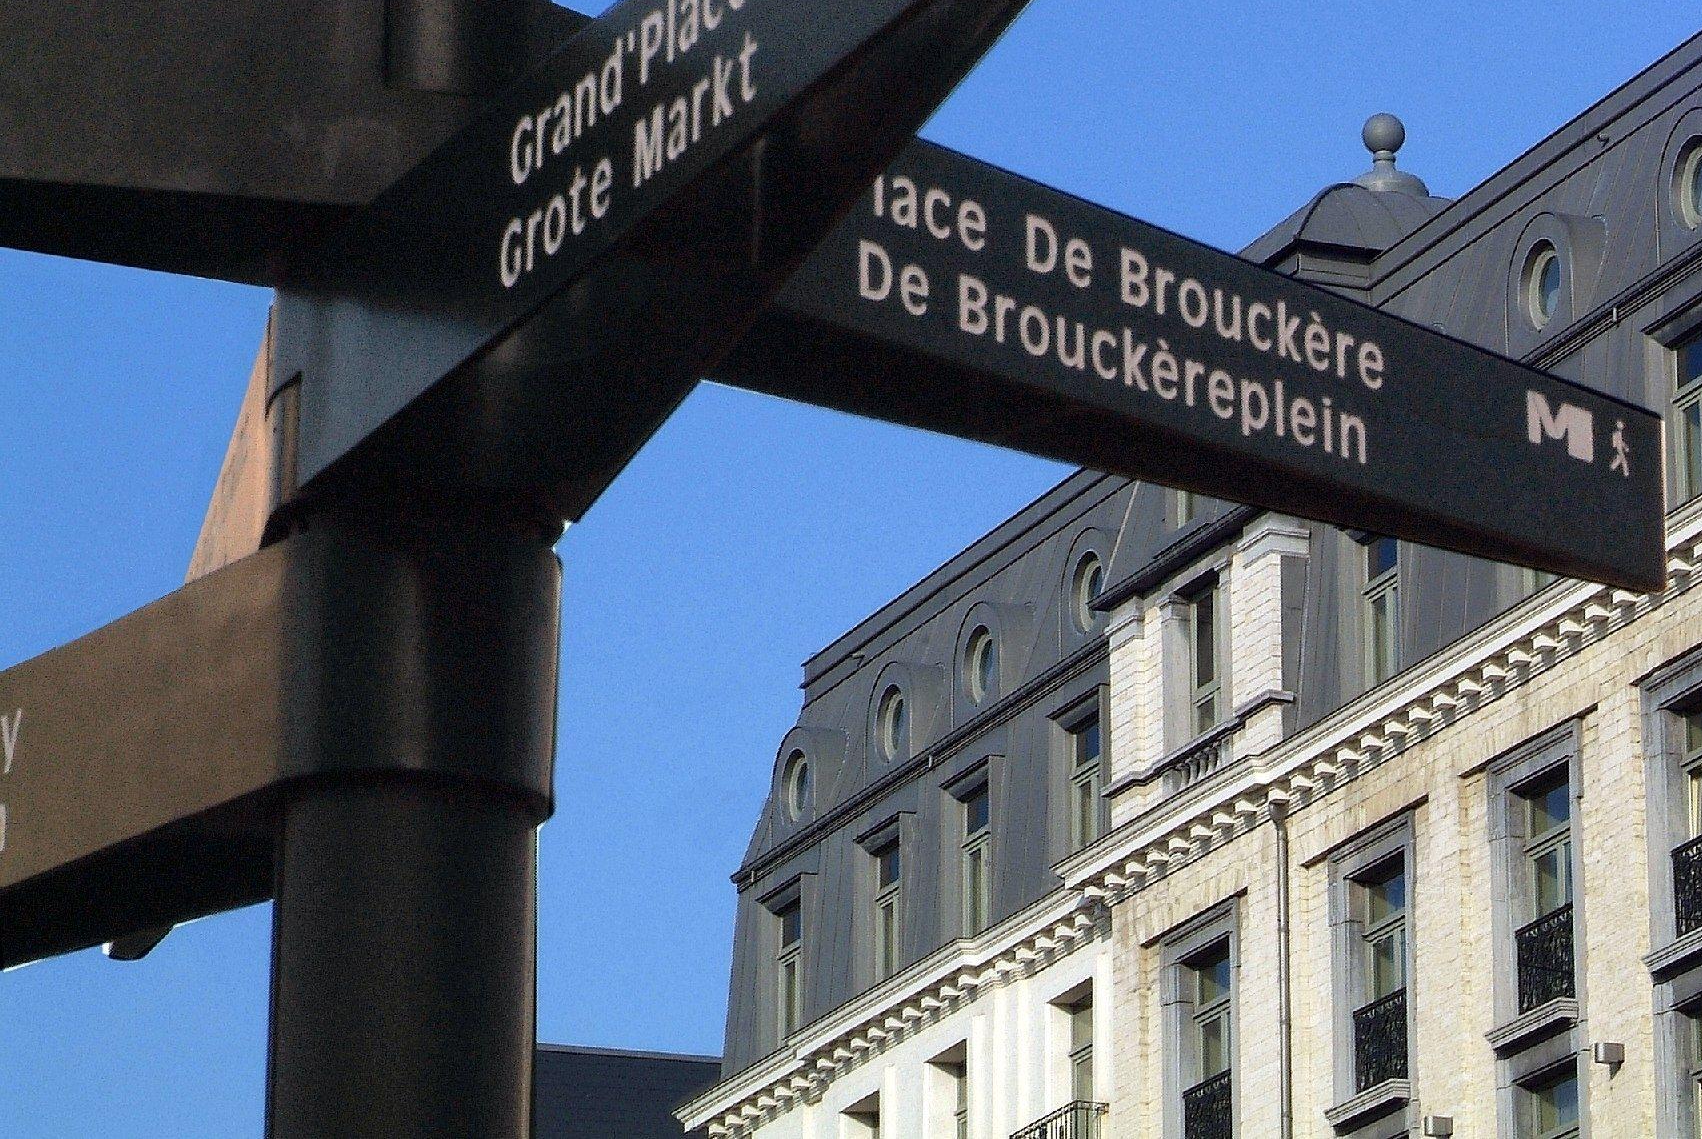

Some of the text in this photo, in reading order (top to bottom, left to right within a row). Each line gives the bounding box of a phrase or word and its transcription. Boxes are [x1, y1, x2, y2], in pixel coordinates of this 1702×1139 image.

[499, 30, 758, 288] Grote Markt
[858, 238, 1367, 465] De Brouckèreplein
[1025, 212, 1094, 289] De
[1120, 245, 1386, 391] Brouckère
